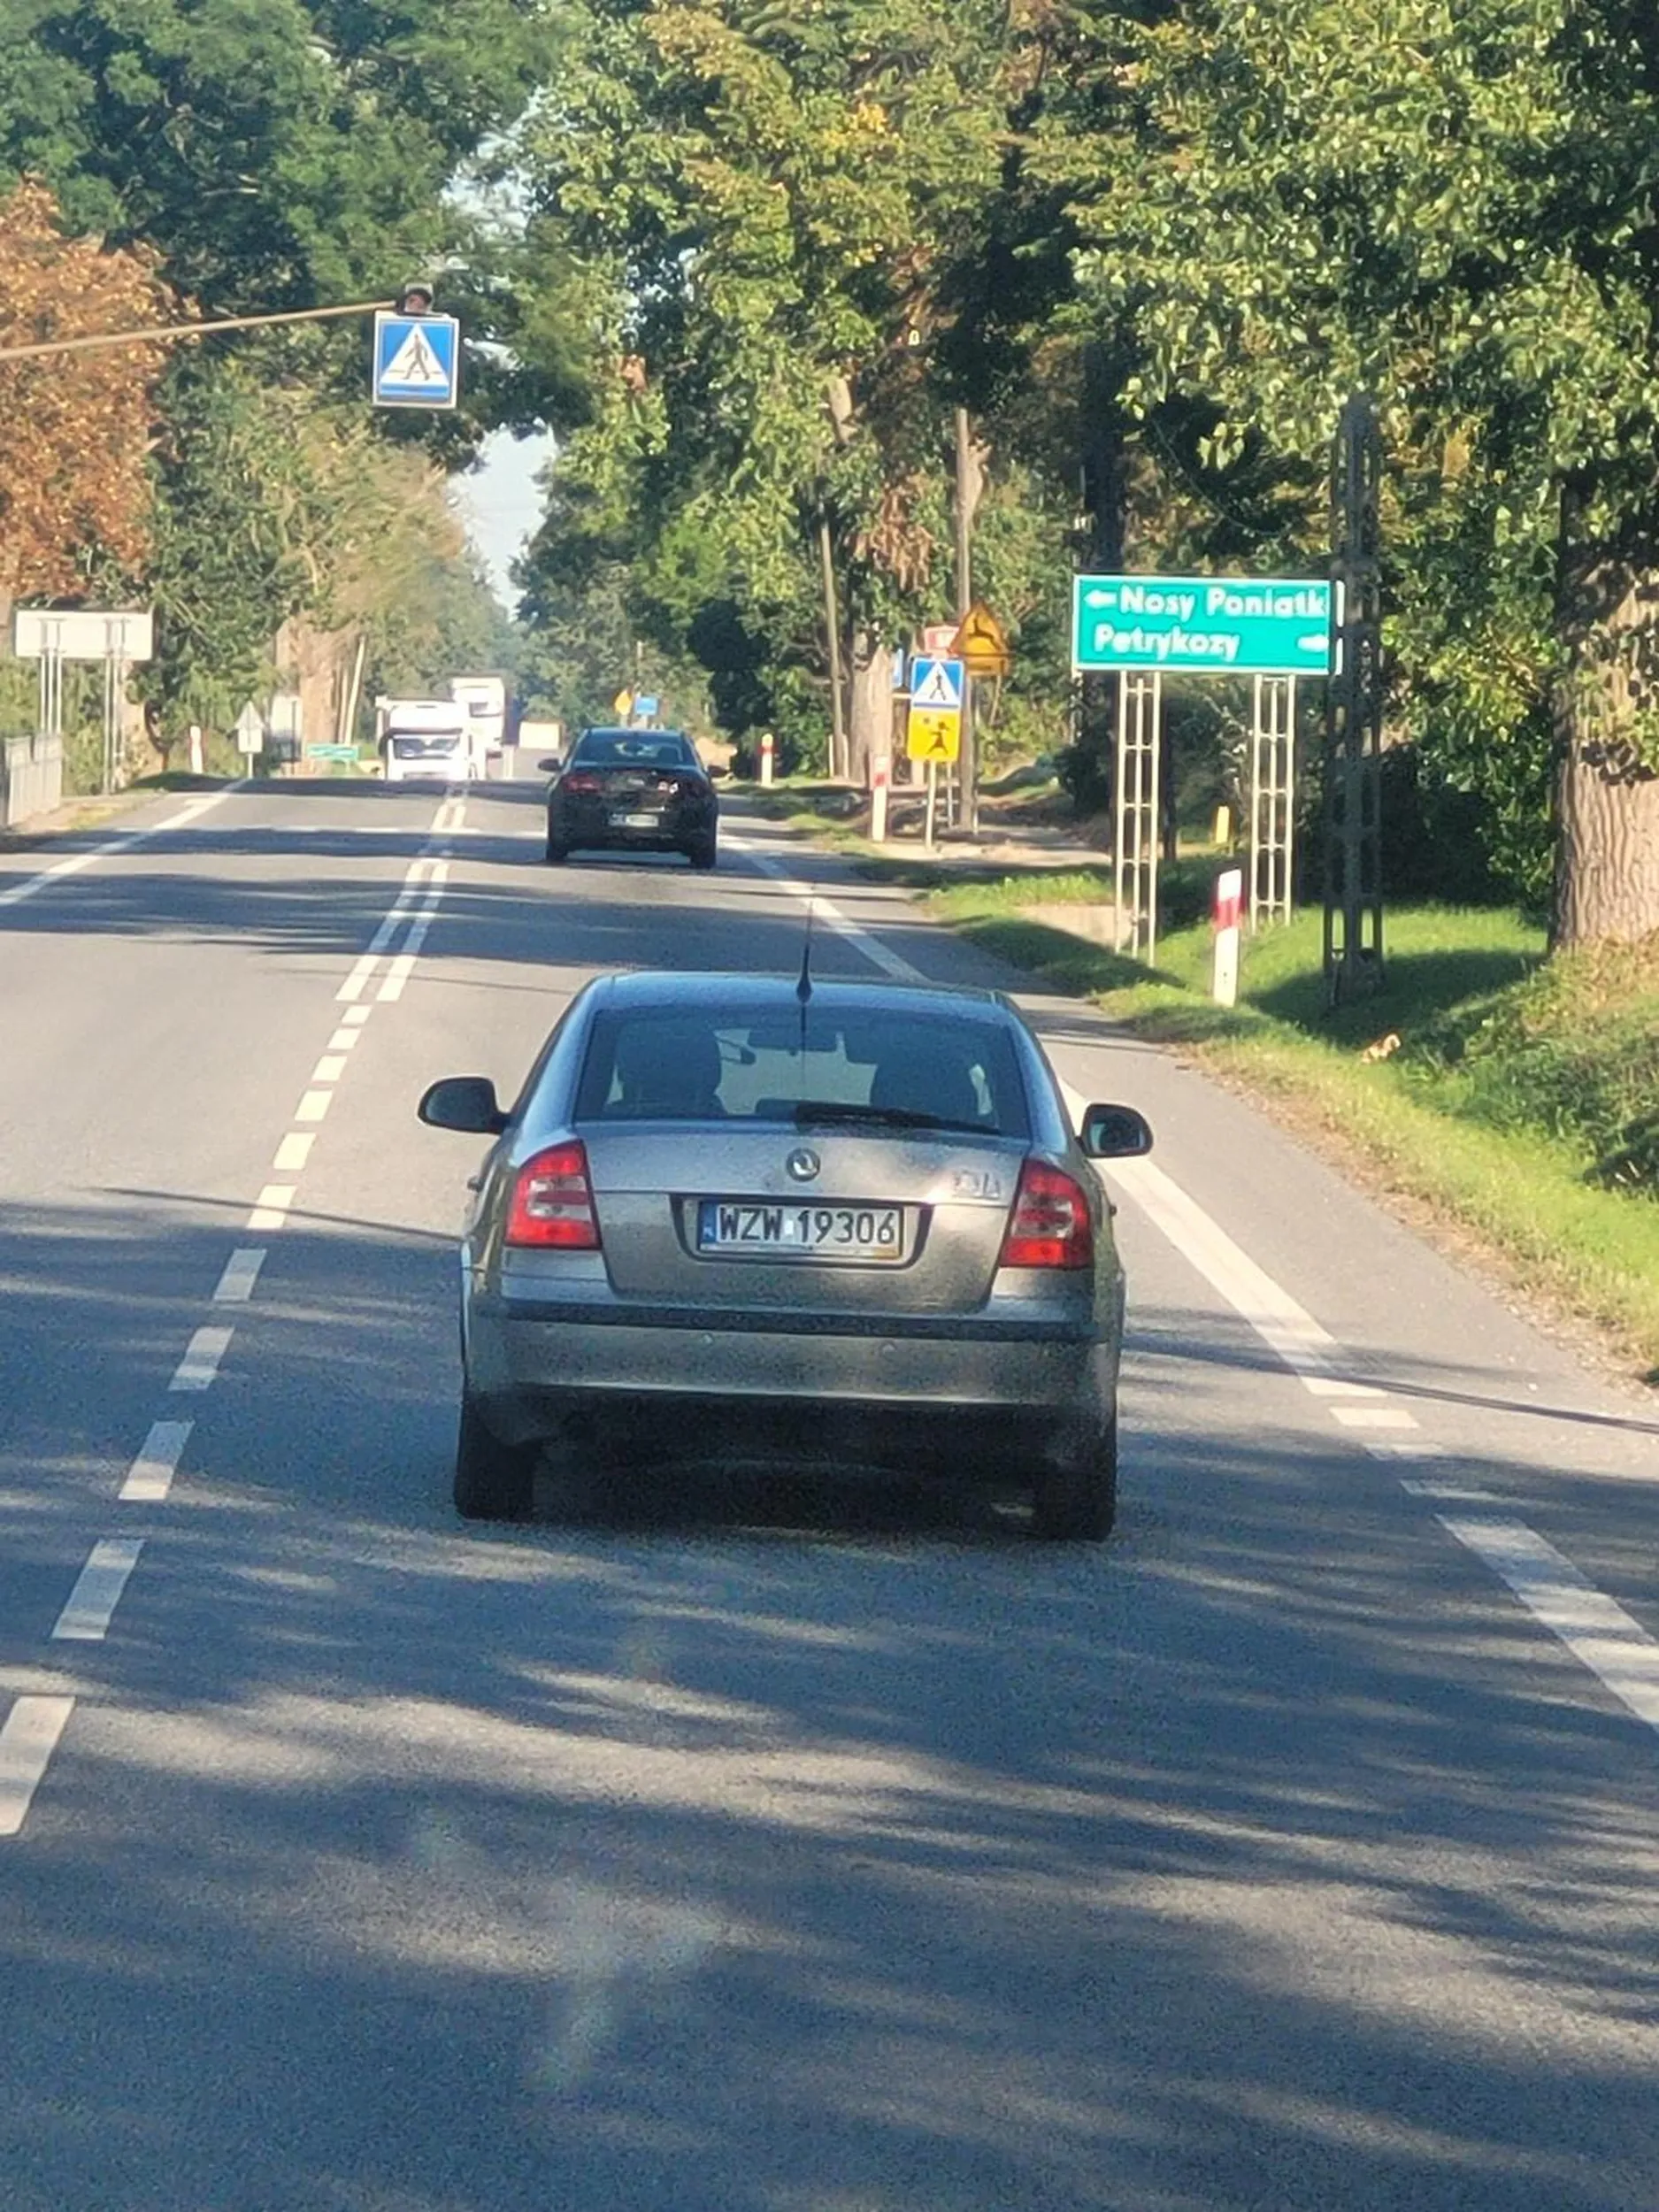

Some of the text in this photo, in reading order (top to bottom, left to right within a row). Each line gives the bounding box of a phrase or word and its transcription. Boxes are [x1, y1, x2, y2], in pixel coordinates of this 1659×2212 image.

[1120, 585, 1329, 622] Nosy Poniatk
[1094, 623, 1240, 663] Petrykozy
[719, 1207, 895, 1245] WZW 19306
